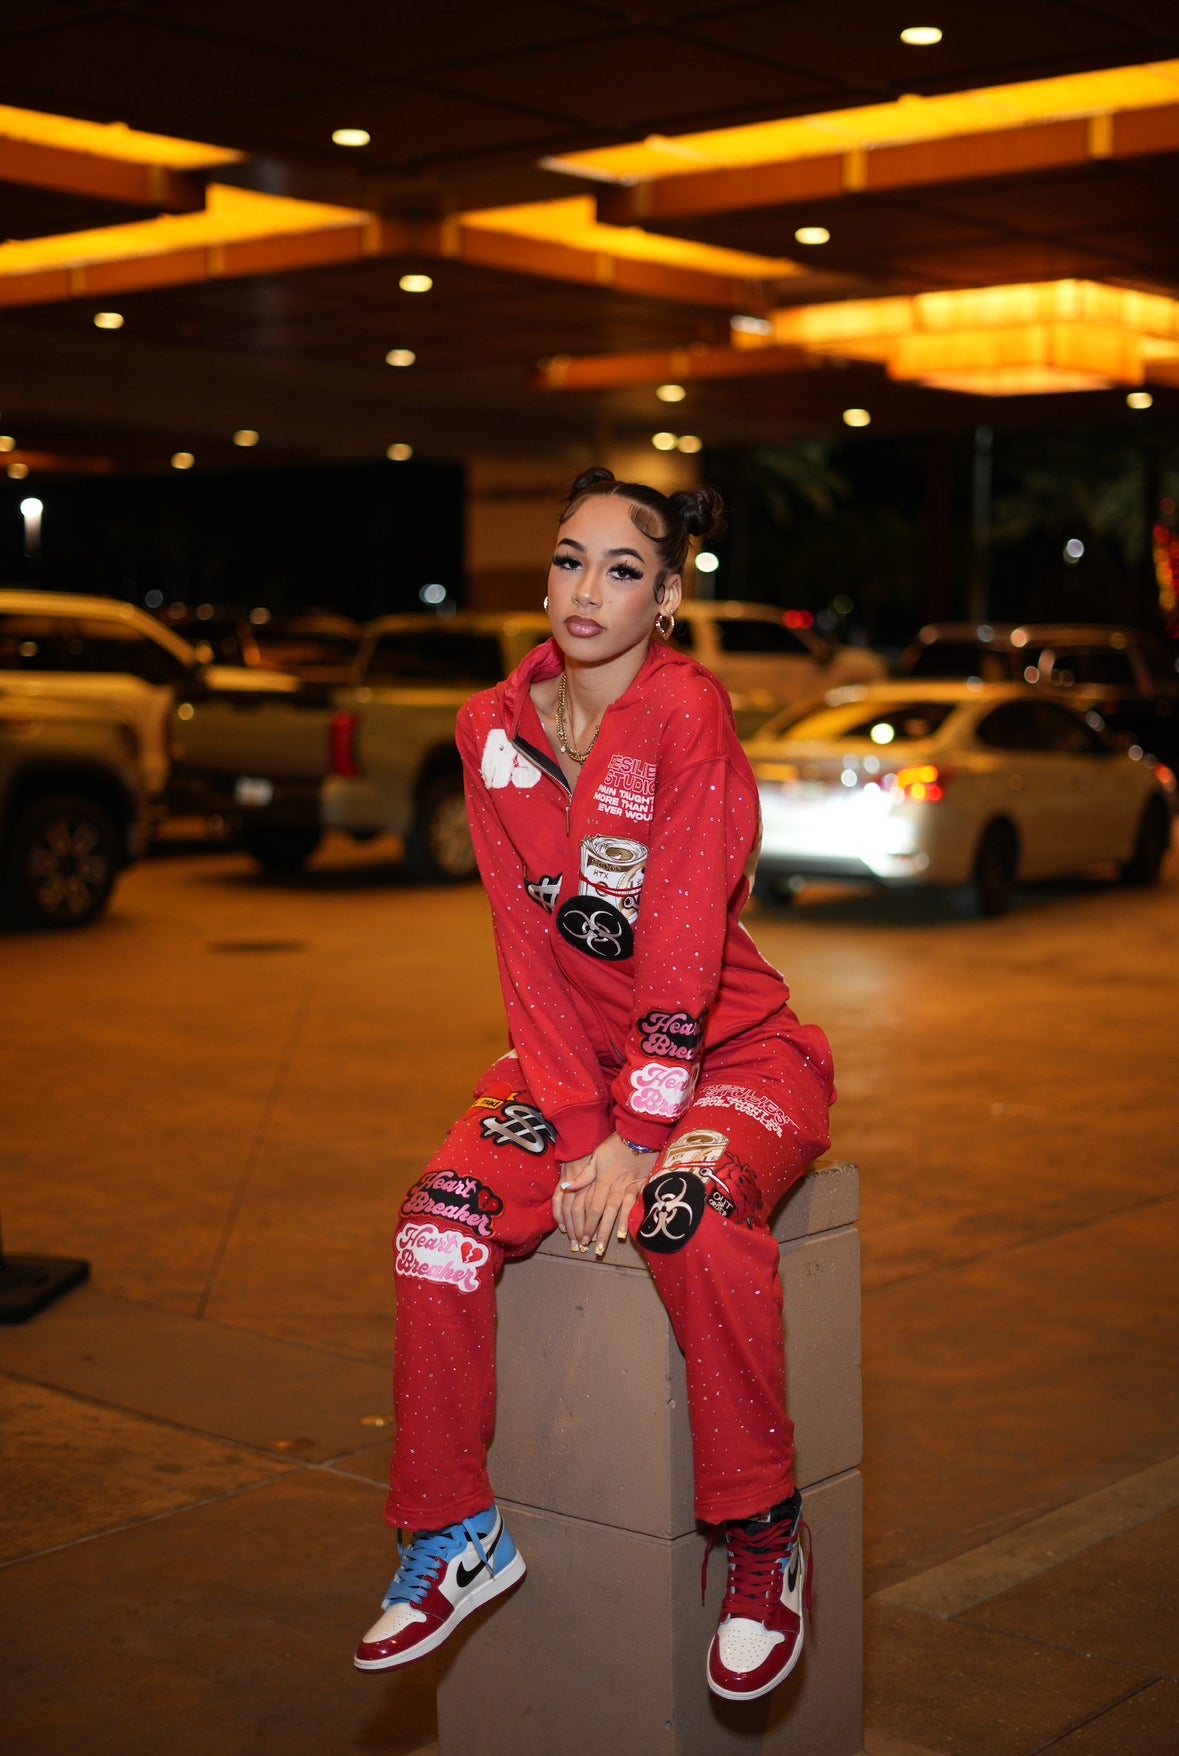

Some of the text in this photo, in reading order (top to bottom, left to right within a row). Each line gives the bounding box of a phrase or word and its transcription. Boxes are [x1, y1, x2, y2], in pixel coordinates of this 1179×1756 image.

[604, 769, 655, 796] STUDIO
[593, 792, 619, 806] MORE
[621, 800, 648, 813] THAN
[597, 803, 653, 821] EVER WOU
[636, 1067, 688, 1092] Hea
[411, 1171, 477, 1198] Heart
[402, 1191, 491, 1236] Breaker
[713, 1191, 733, 1209] OUT
[399, 1226, 459, 1254] Heart
[397, 1249, 476, 1290] Breaker
